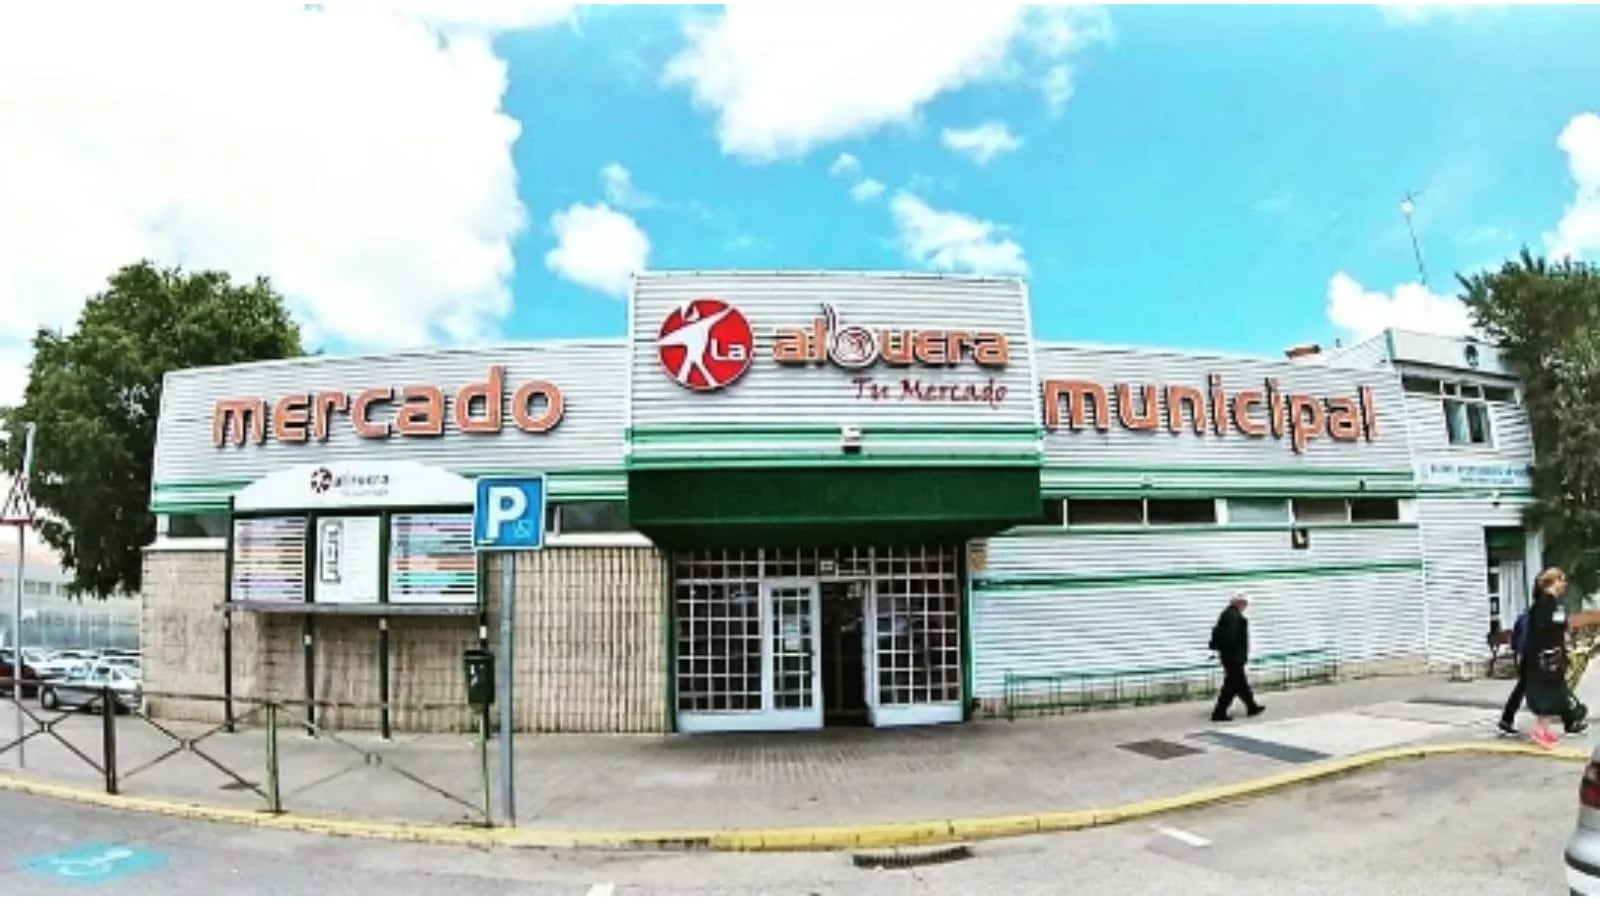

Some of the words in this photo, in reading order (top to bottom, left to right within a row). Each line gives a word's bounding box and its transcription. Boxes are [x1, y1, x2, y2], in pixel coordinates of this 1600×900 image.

[711, 338, 746, 361] La
[773, 303, 1009, 371] albuera
[212, 364, 565, 448] mercado
[852, 376, 890, 400] Tu
[901, 376, 1008, 410] Mercado
[1043, 373, 1380, 454] municipal
[486, 486, 527, 540] P
